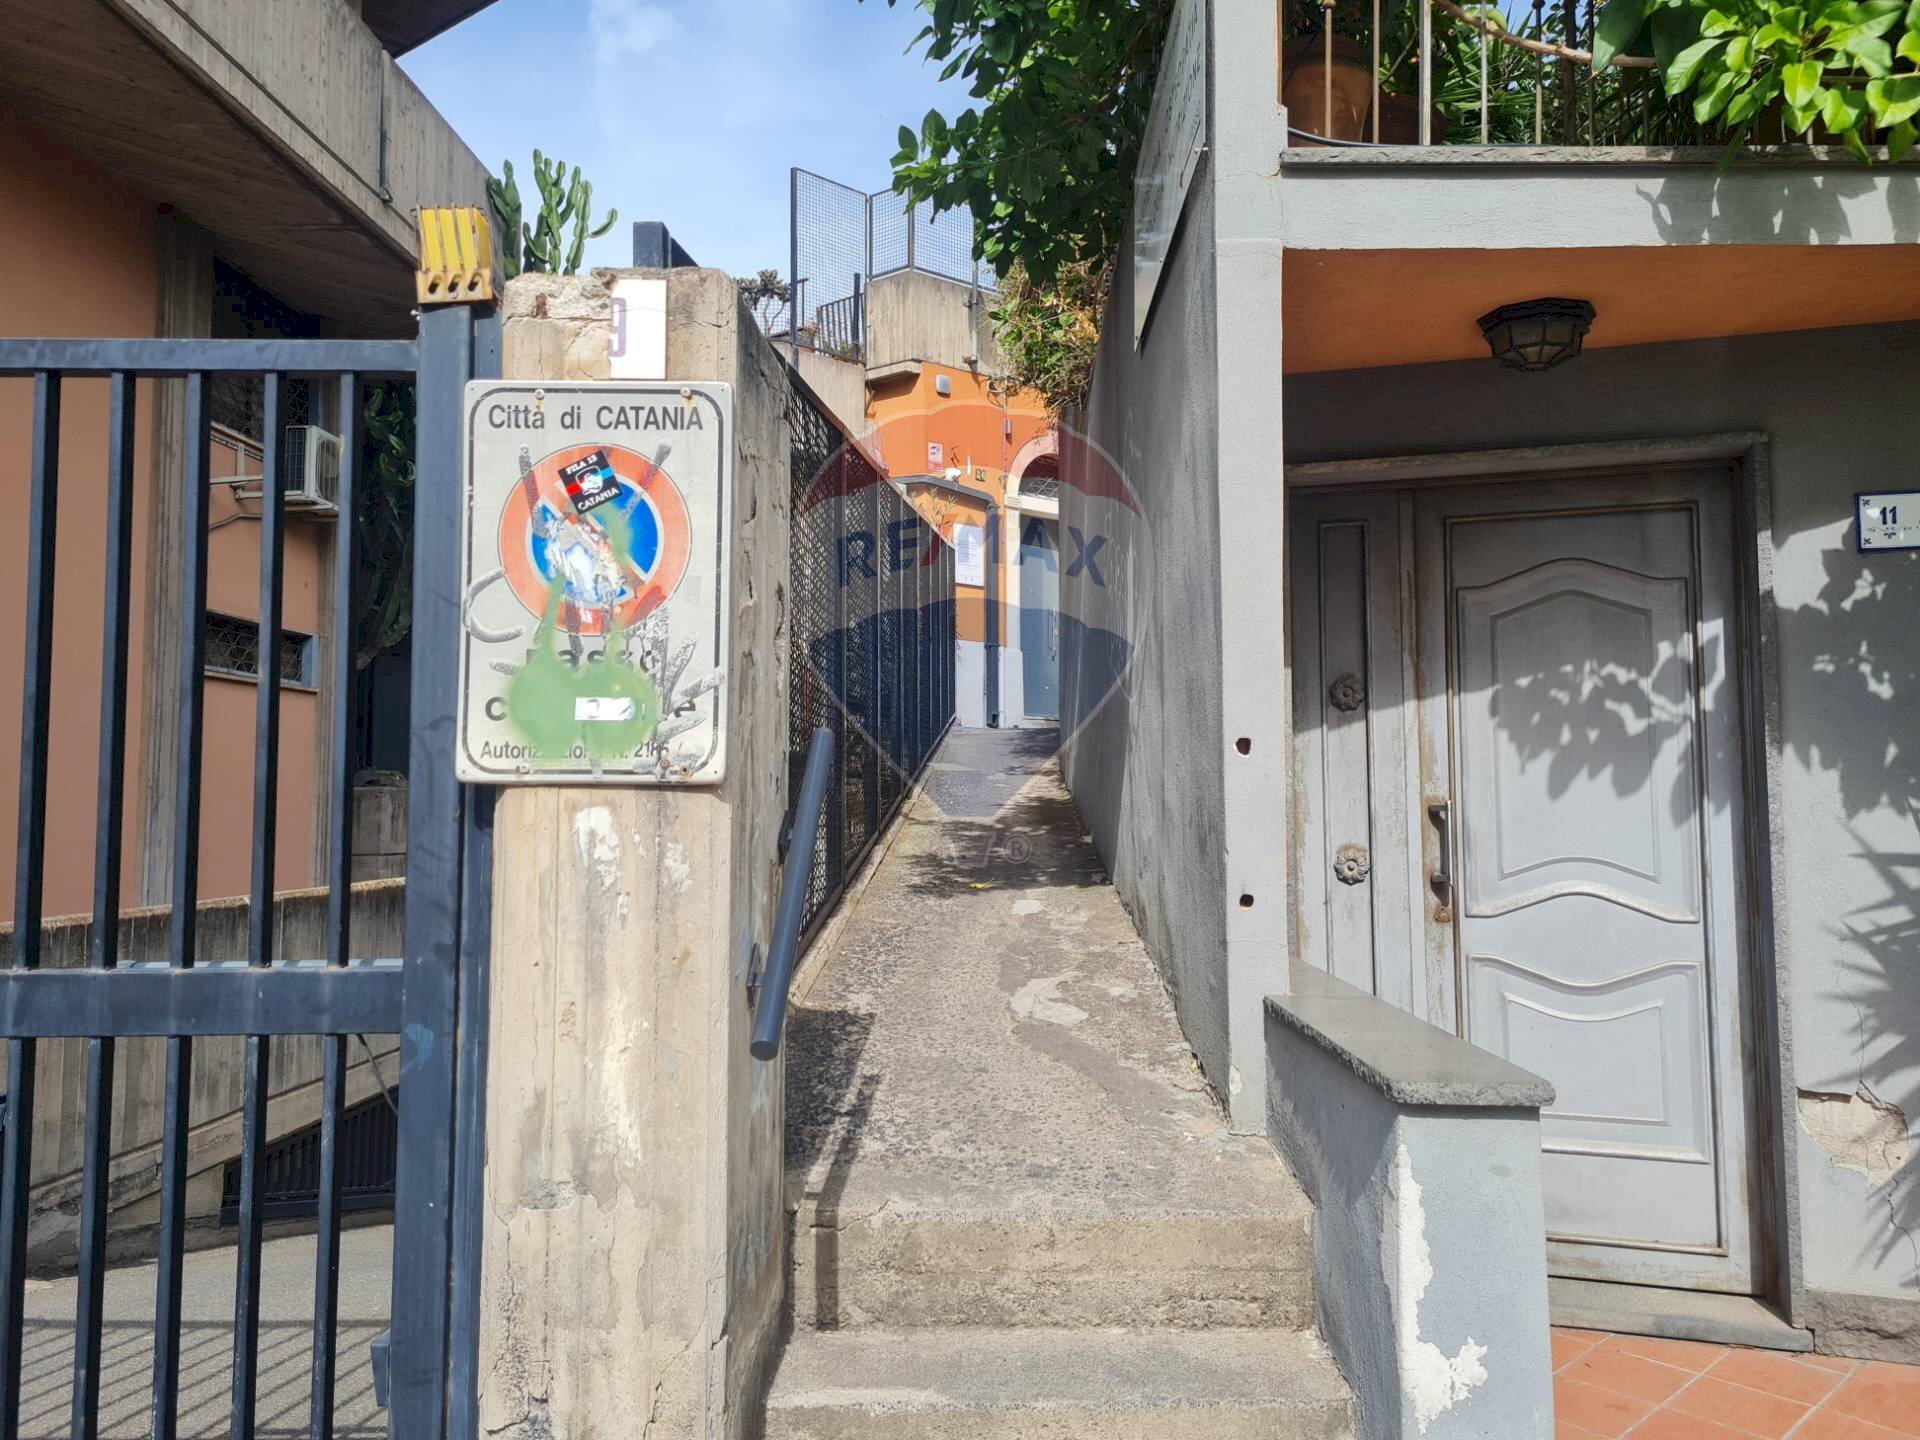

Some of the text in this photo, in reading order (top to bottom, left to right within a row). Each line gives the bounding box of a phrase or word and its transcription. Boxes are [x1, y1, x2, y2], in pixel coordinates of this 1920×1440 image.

[488, 403, 704, 431] Città di CATANIA
[565, 460, 588, 475] FILA
[577, 486, 620, 511] CATANIA
[1880, 506, 1897, 525] 11
